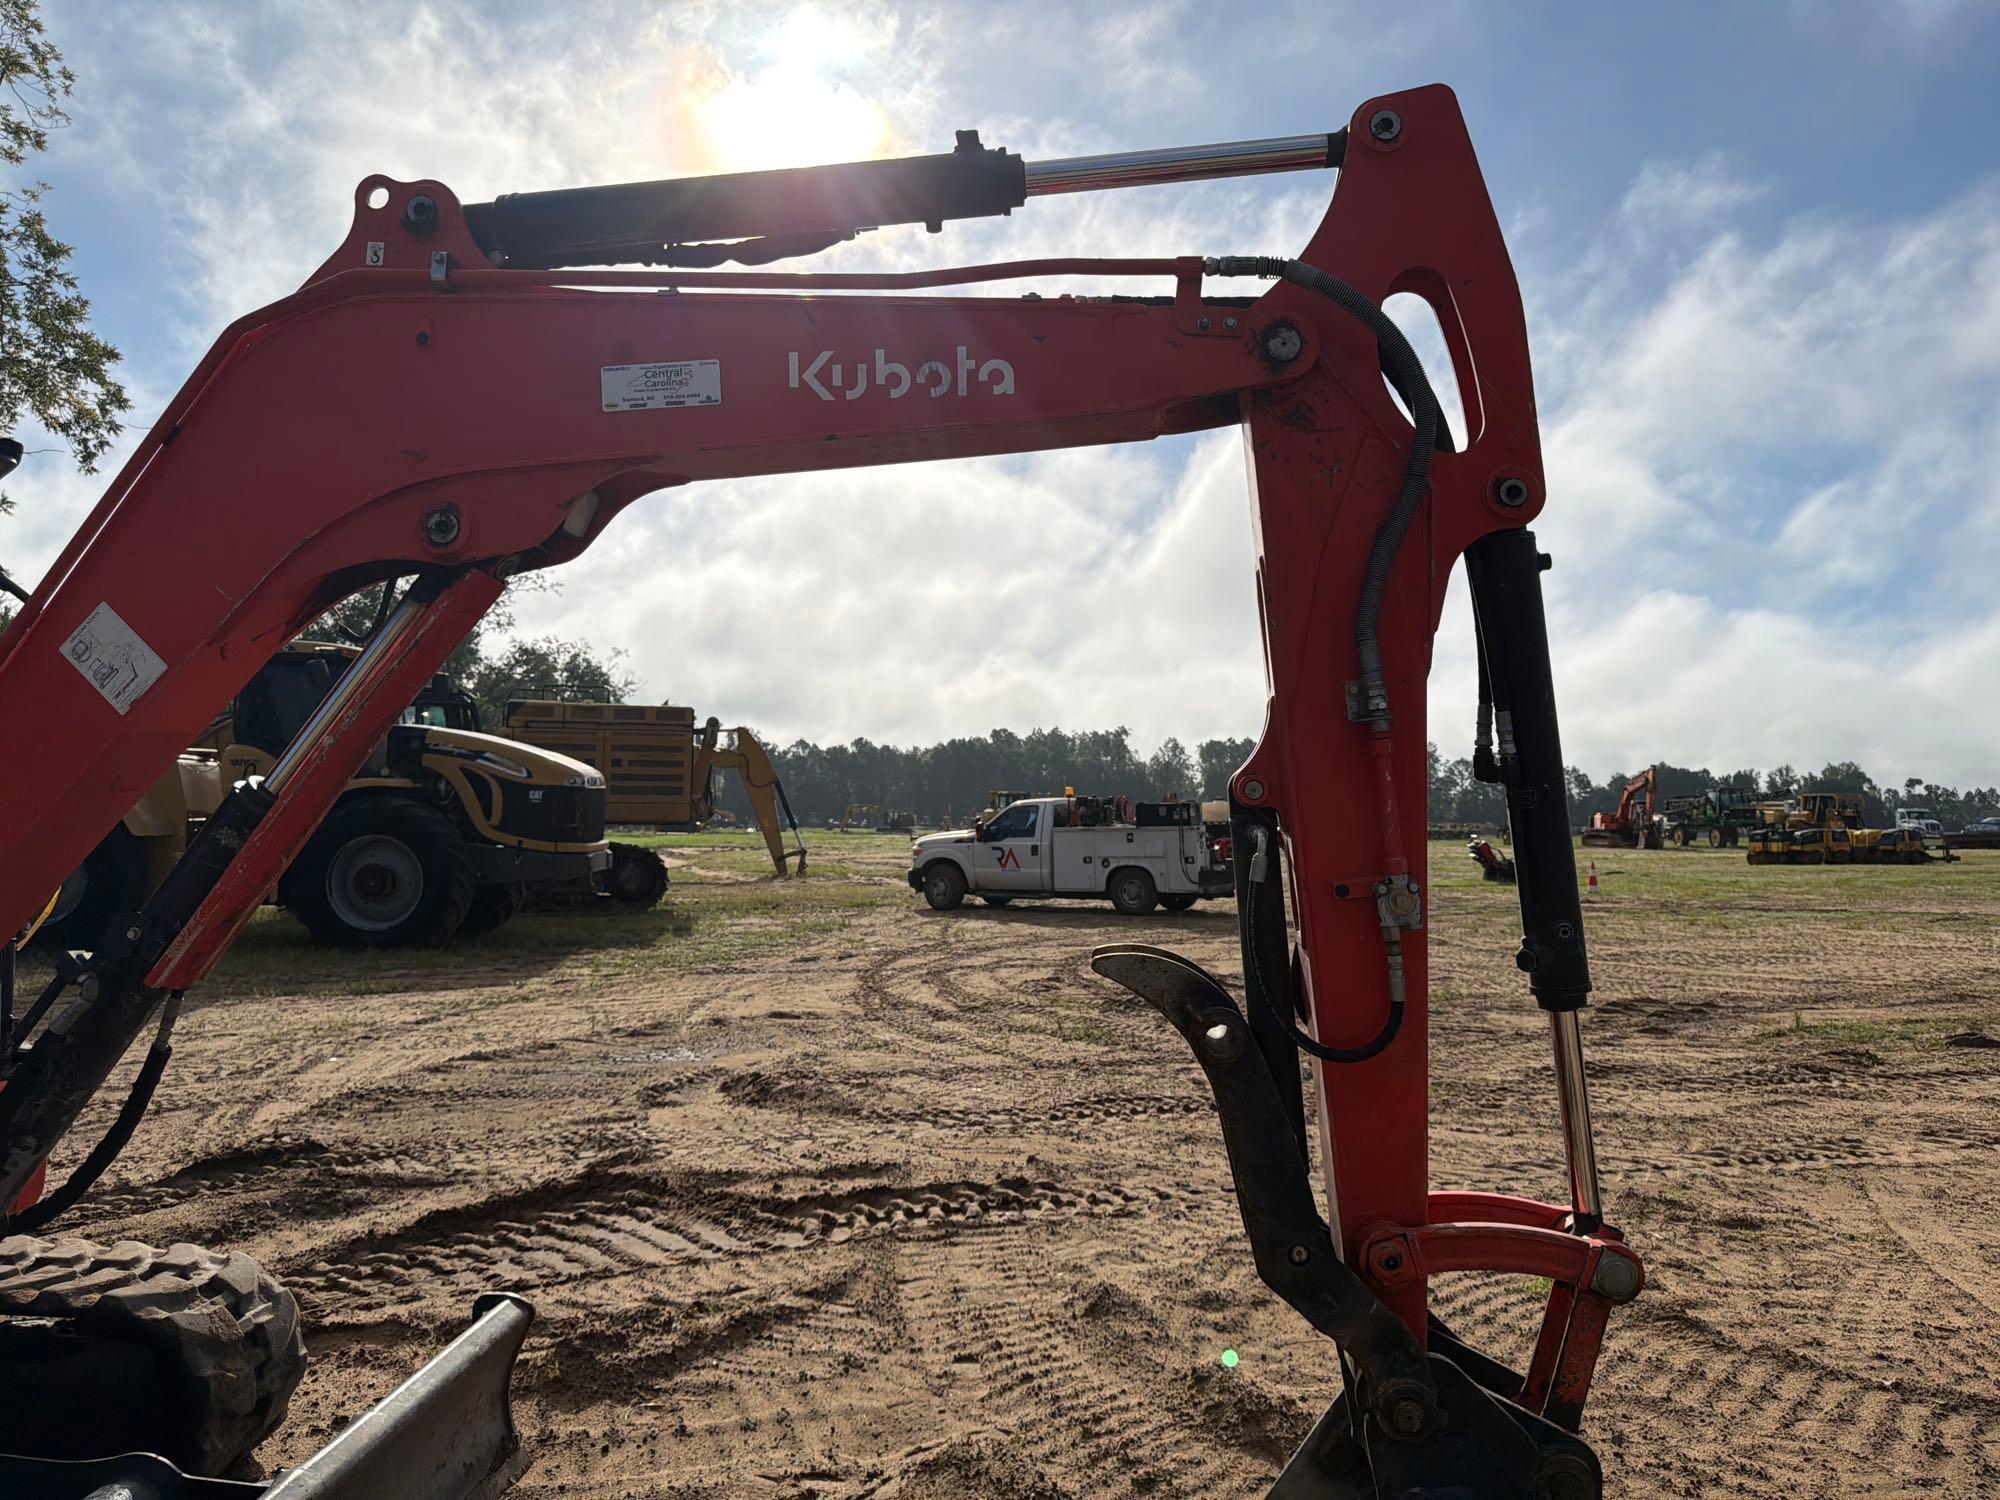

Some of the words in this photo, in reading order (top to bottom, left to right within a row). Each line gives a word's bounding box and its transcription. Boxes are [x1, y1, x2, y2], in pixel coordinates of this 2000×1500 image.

[644, 369, 683, 379] Central
[788, 346, 1015, 400] Kubota
[644, 378, 684, 388] Carolina
[529, 790, 544, 799] CAT
